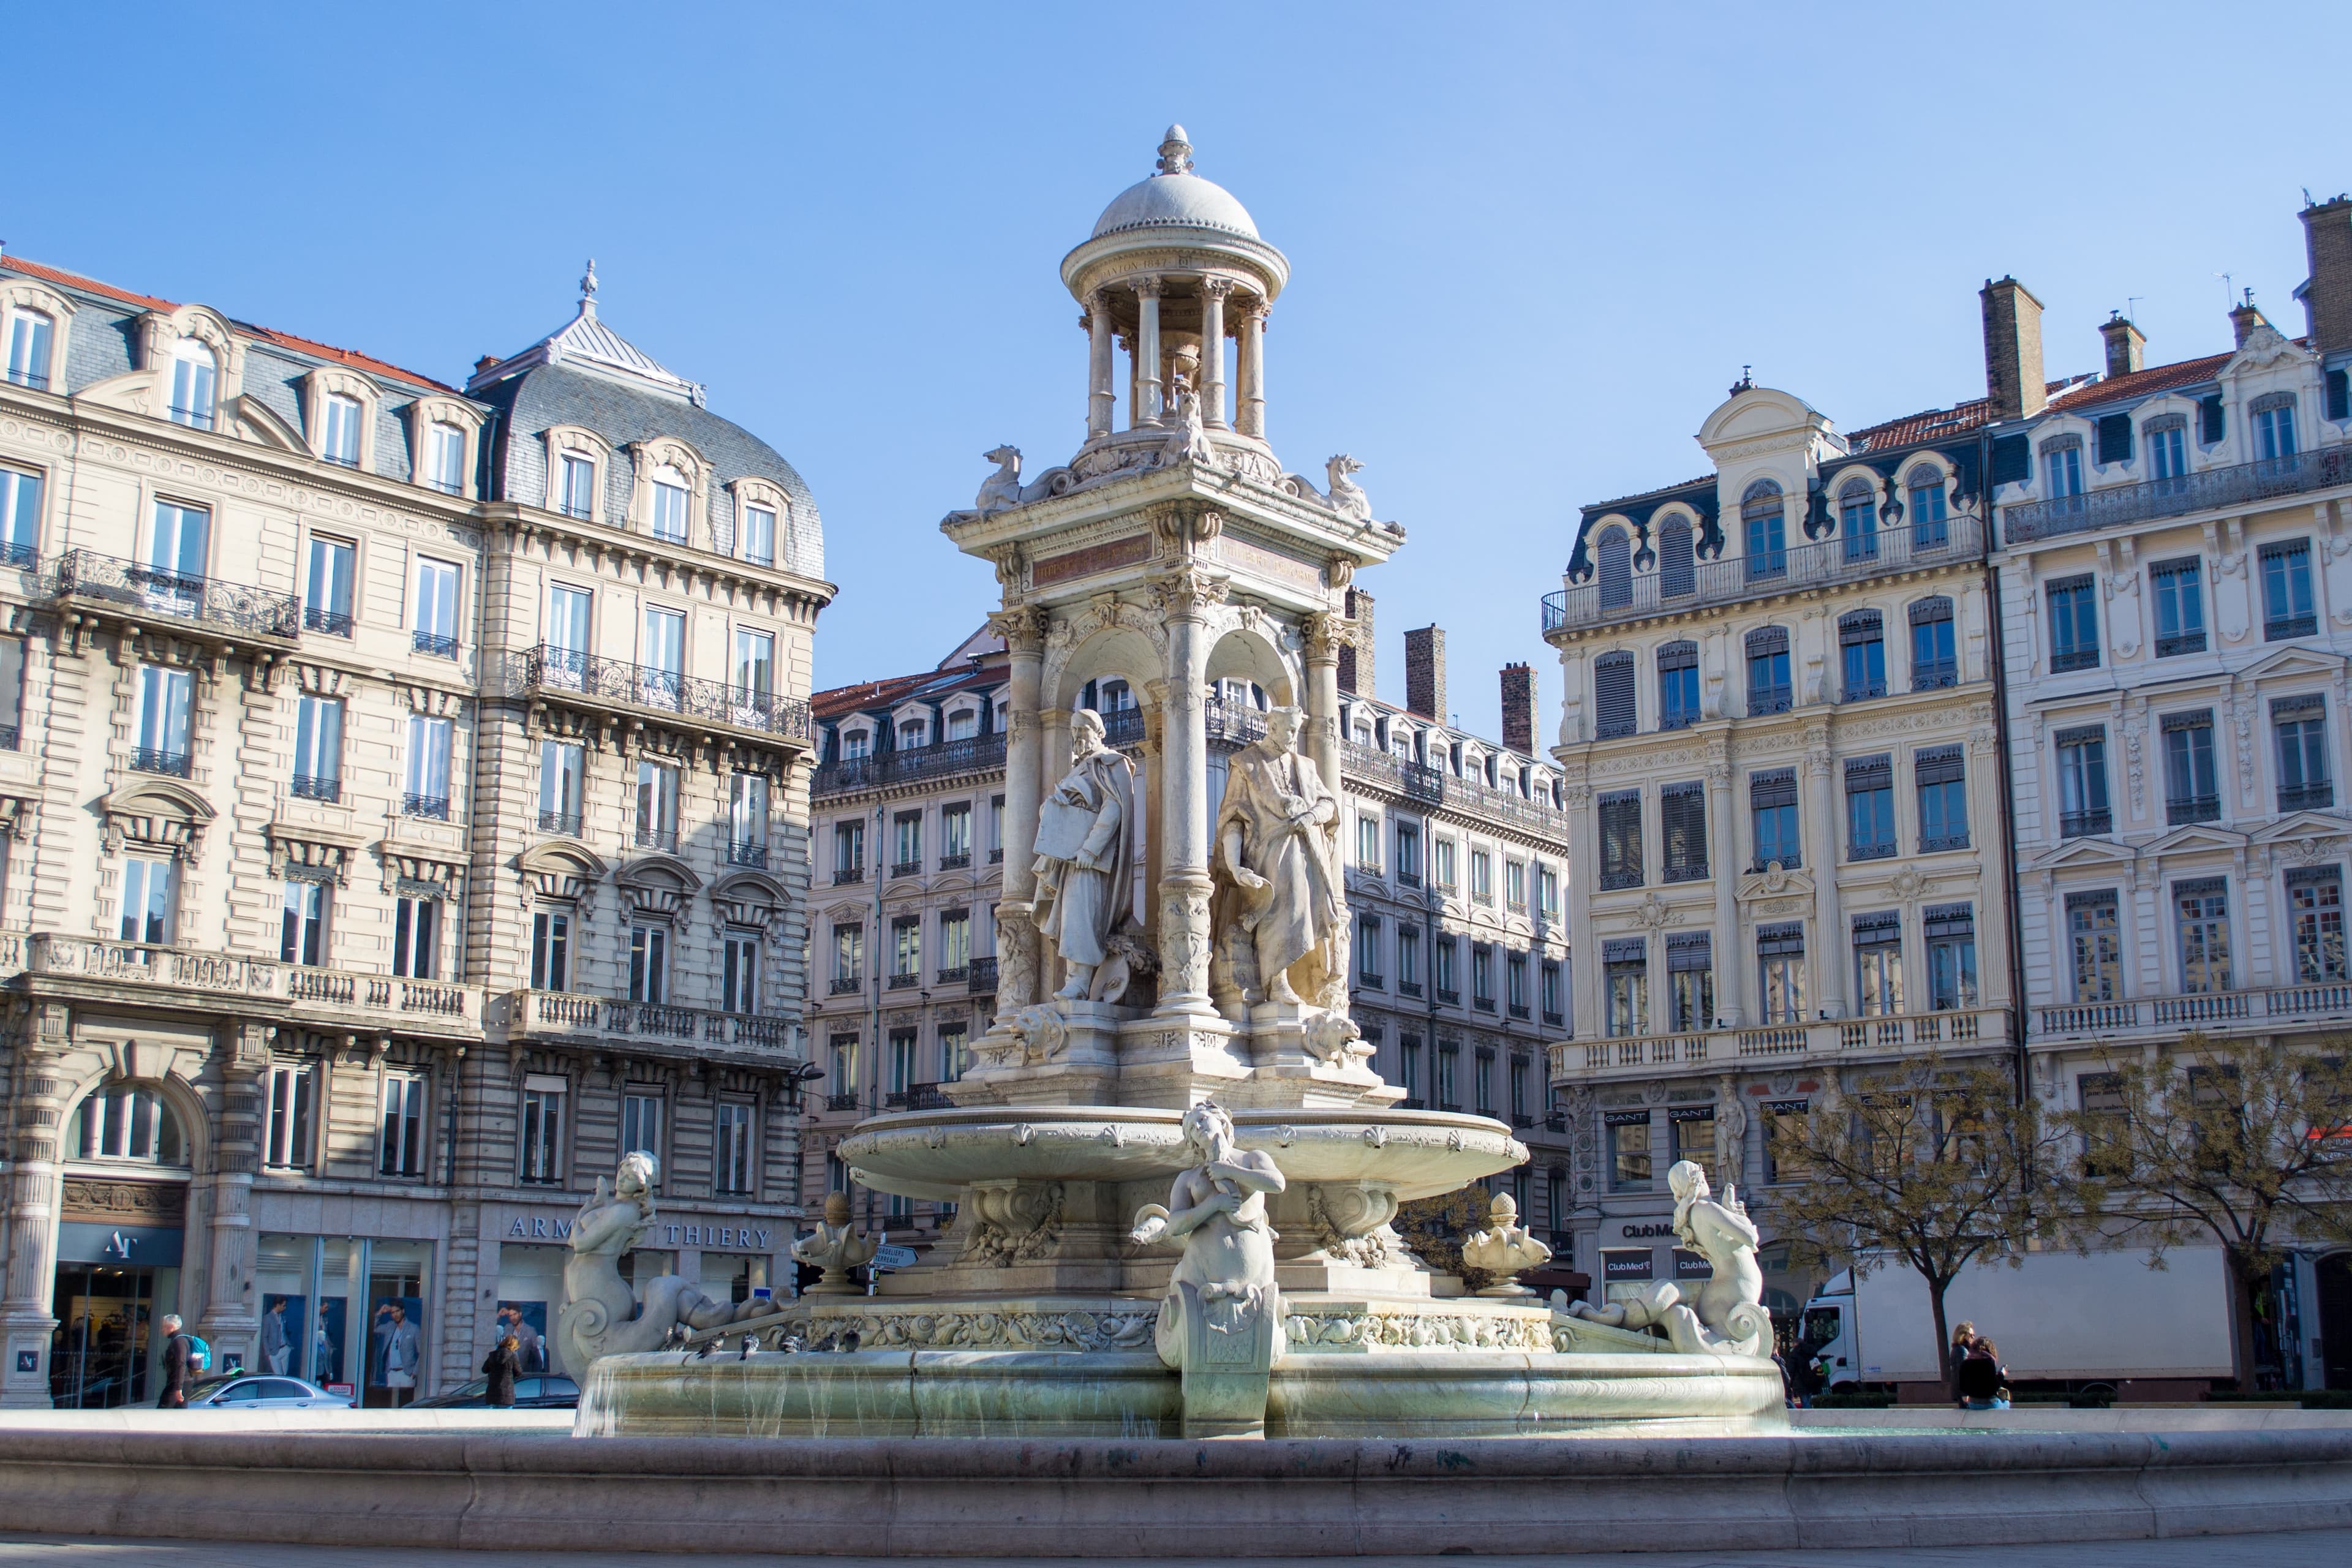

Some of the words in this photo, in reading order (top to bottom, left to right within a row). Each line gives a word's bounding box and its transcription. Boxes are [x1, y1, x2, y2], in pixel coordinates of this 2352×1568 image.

[1763, 1102, 1806, 1110] GANT
[1605, 1113, 1646, 1122] GANT
[1669, 1109, 1711, 1118] GANT
[510, 1216, 575, 1237] ARM
[665, 1225, 770, 1248] THIERY
